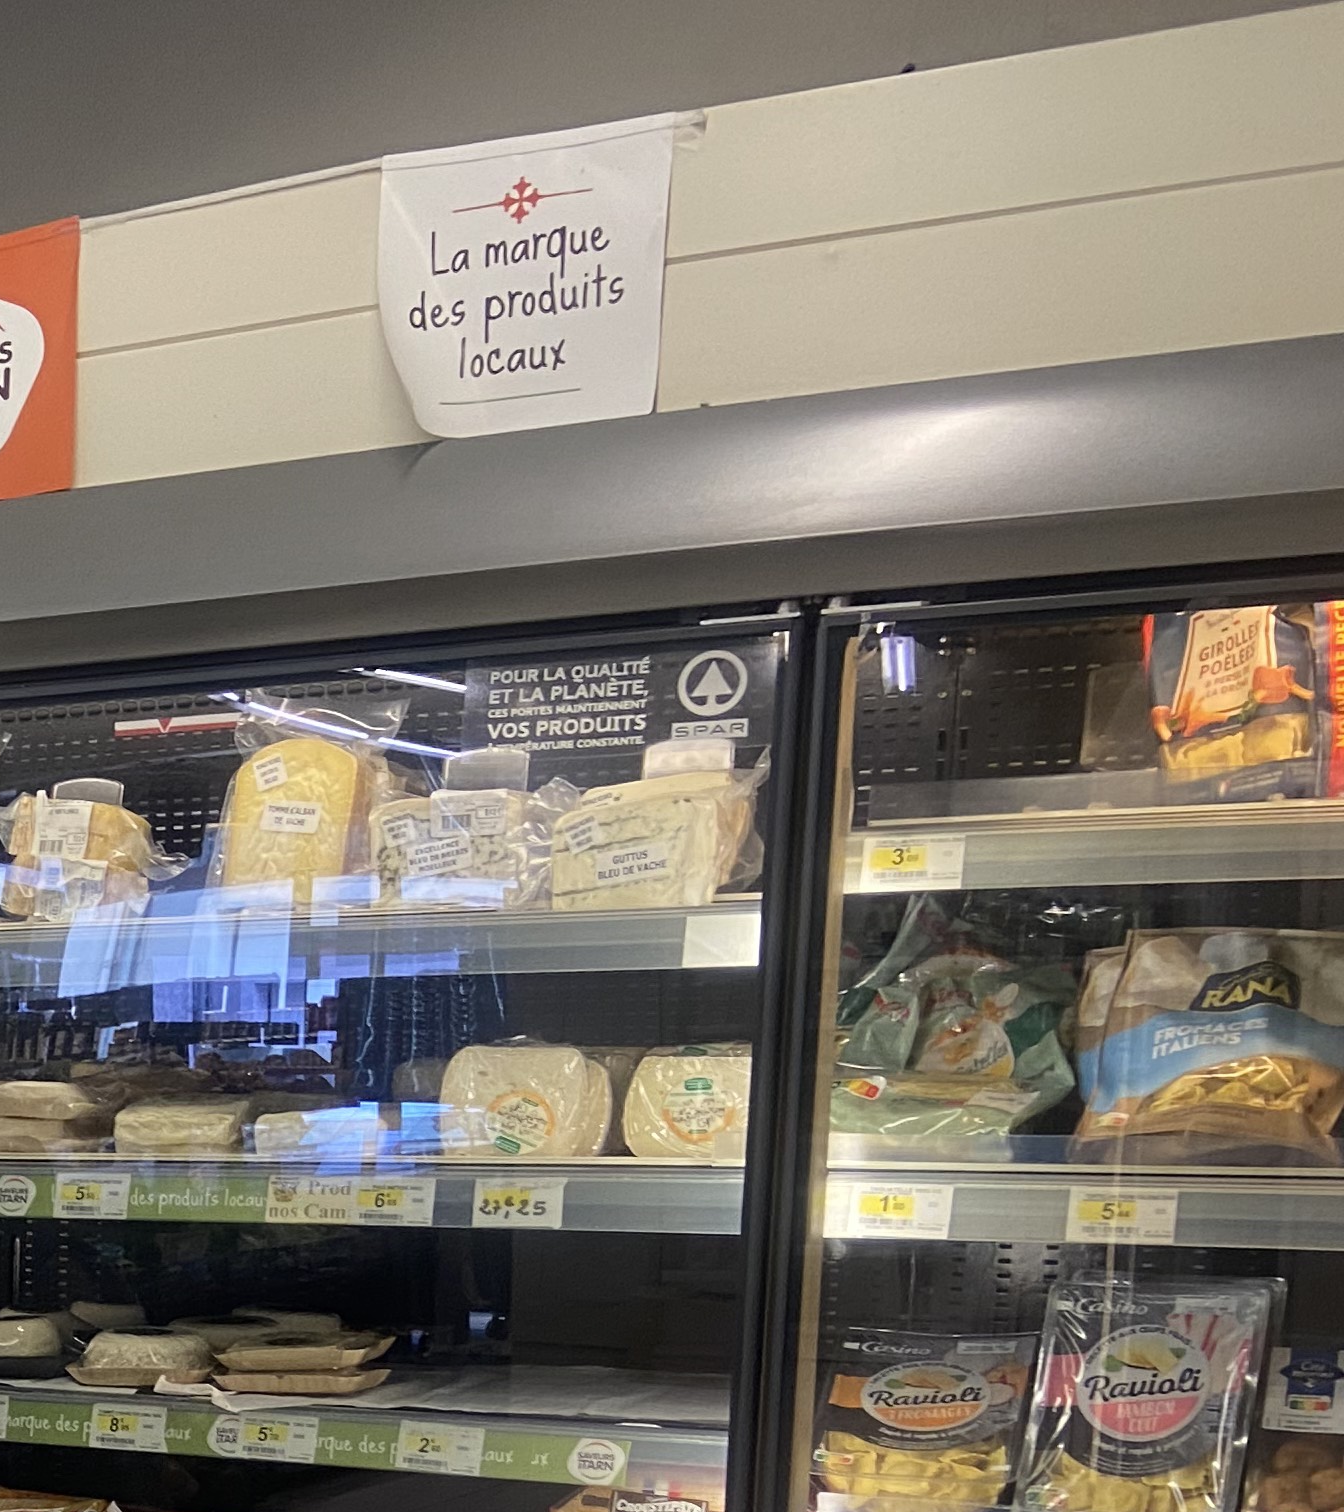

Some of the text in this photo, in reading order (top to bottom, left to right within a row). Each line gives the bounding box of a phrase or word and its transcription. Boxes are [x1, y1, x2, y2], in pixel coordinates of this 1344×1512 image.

[431, 225, 611, 279] La marque
[409, 263, 625, 343] des produits
[460, 337, 566, 379] locaux
[490, 656, 651, 685] POUR LA QUALITÉ
[488, 678, 649, 705] ET LA PLANÈTE,
[488, 699, 648, 719] CES PORTES MAINTIENNENT
[487, 714, 647, 739] VOS PRODUITS
[674, 722, 745, 738] SPAR
[611, 850, 648, 866] GUTTUS
[1201, 976, 1291, 1010] RANA
[1153, 1016, 1269, 1044] FROMAGES
[1151, 1030, 1242, 1059] ITALIENS
[129, 1189, 155, 1207] des
[158, 1188, 219, 1213] produits
[268, 1205, 296, 1219] nos
[1074, 1296, 1150, 1316] Casino
[858, 1340, 932, 1357] Casino
[868, 1386, 985, 1408] Ravioli
[1083, 1369, 1204, 1403] Ravioli
[54, 1414, 80, 1432] des
[358, 1432, 386, 1453] des
